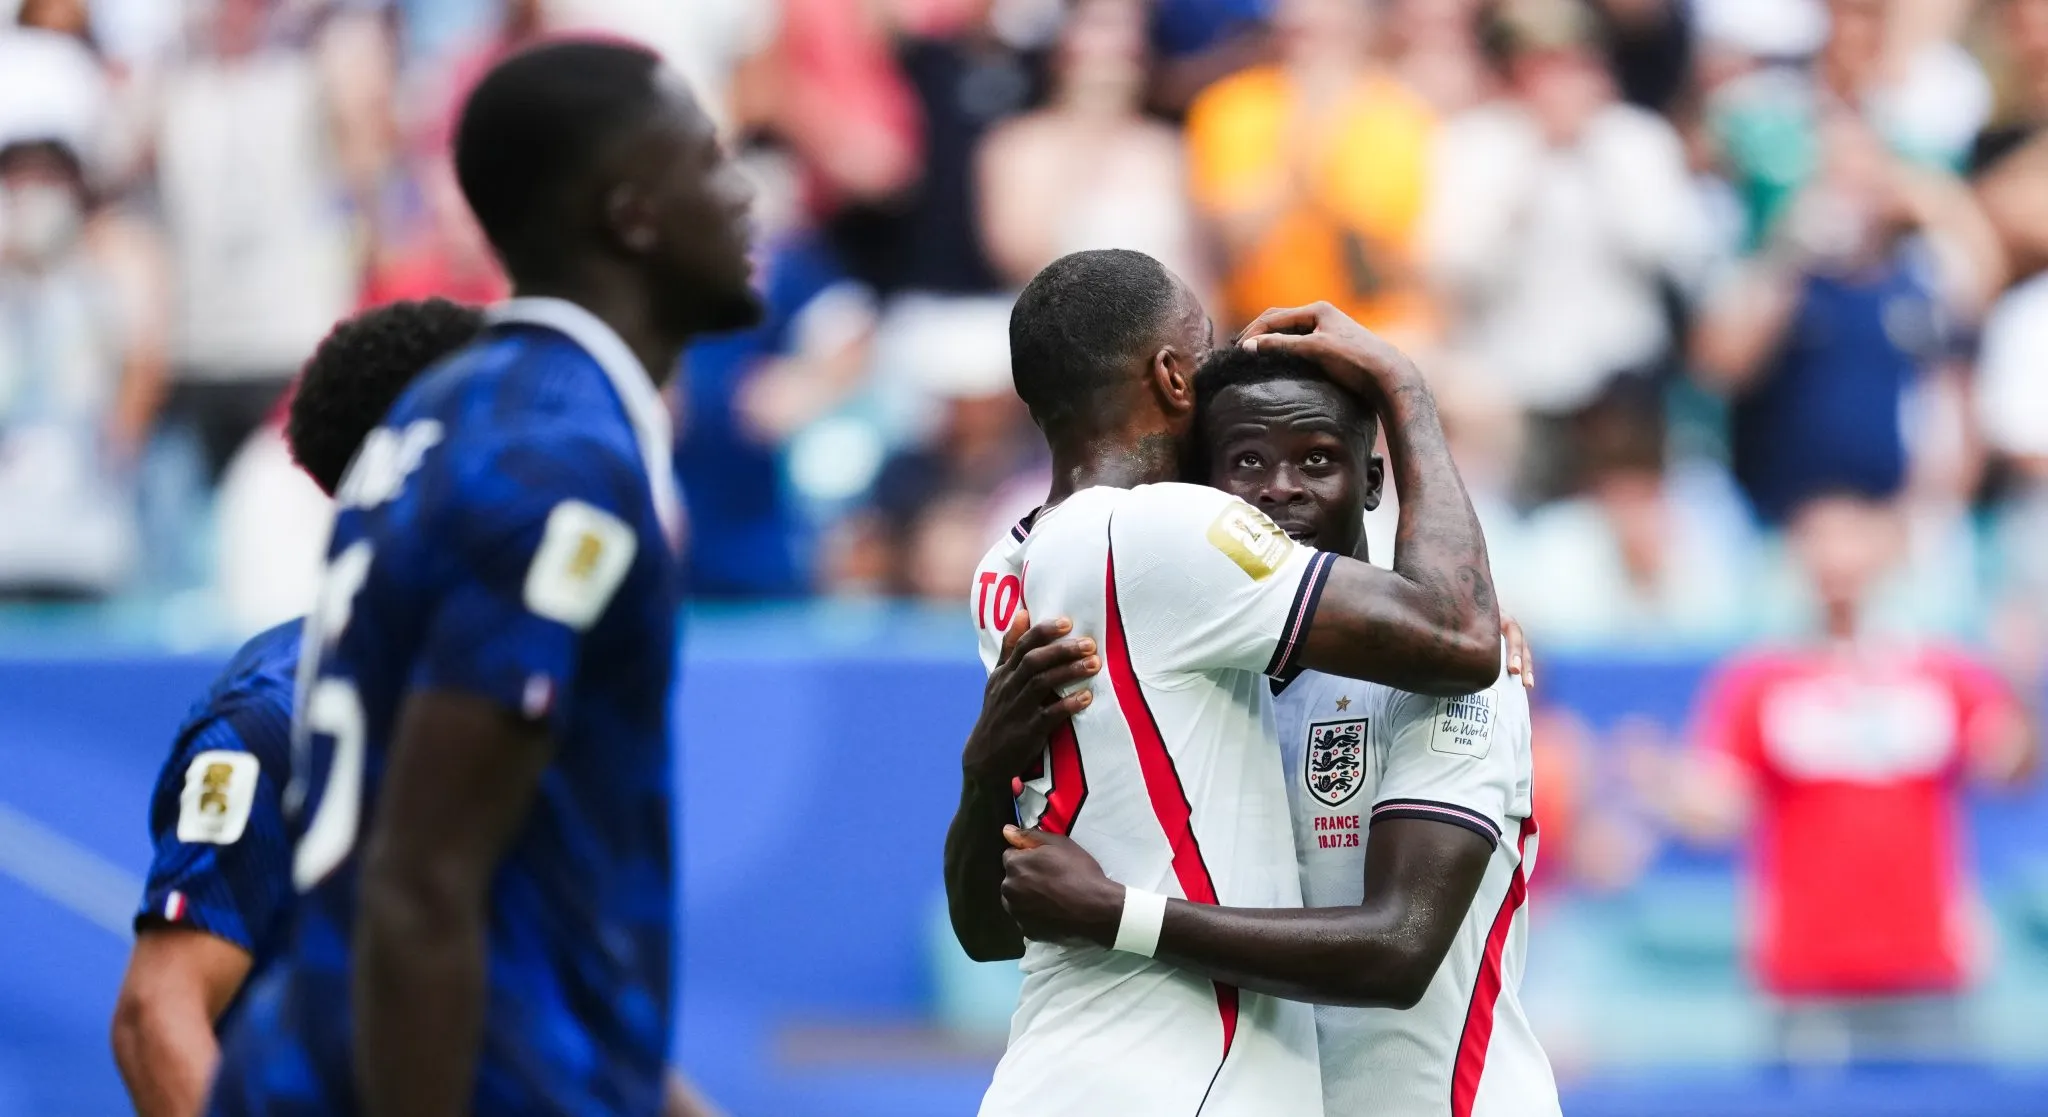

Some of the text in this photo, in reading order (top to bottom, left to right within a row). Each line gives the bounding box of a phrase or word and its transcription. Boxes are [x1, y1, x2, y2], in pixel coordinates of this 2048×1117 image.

[979, 571, 1021, 632] TO
[1446, 702, 1489, 724] UNITES
[1441, 719, 1490, 741] the World
[1454, 736, 1473, 746] FIFA
[1314, 815, 1360, 831] FRANCE
[1318, 833, 1359, 849] 18.07.26
